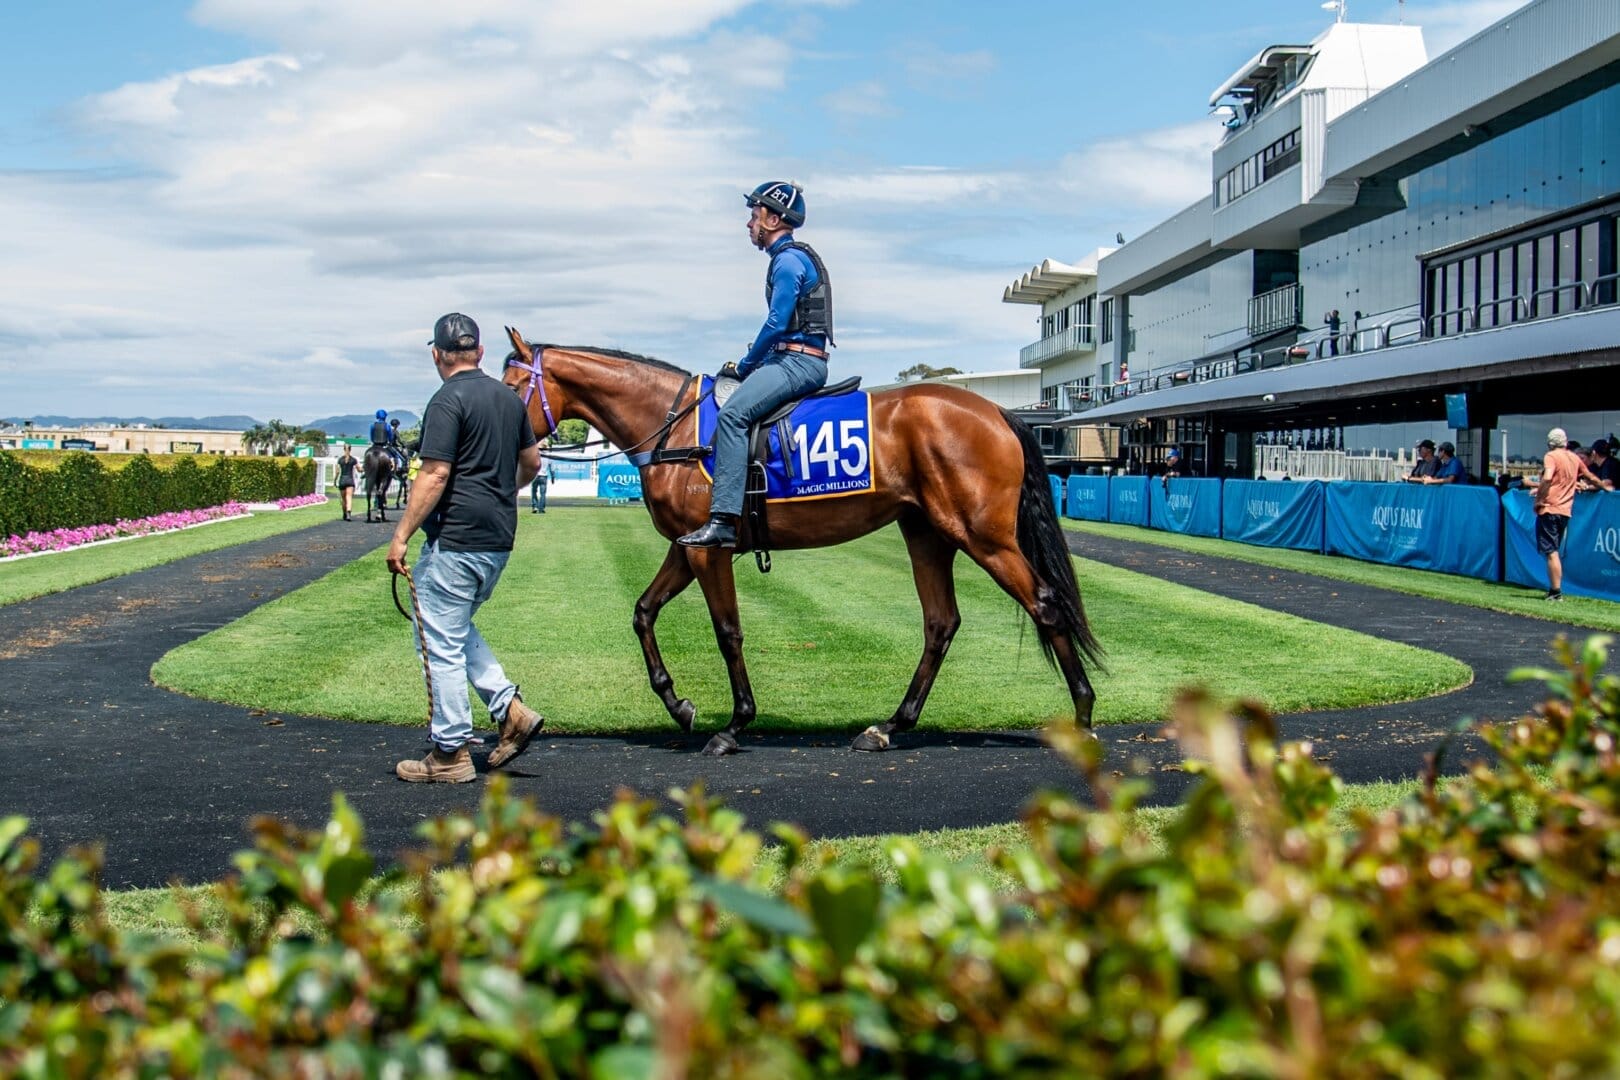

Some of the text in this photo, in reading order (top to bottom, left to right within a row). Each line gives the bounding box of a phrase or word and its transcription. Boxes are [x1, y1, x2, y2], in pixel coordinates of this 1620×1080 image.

[793, 420, 868, 480] 145
[796, 479, 870, 495] MAGIC MILLIONS
[1371, 505, 1423, 530] AQUIS PARK
[1593, 527, 1620, 561] AQ
